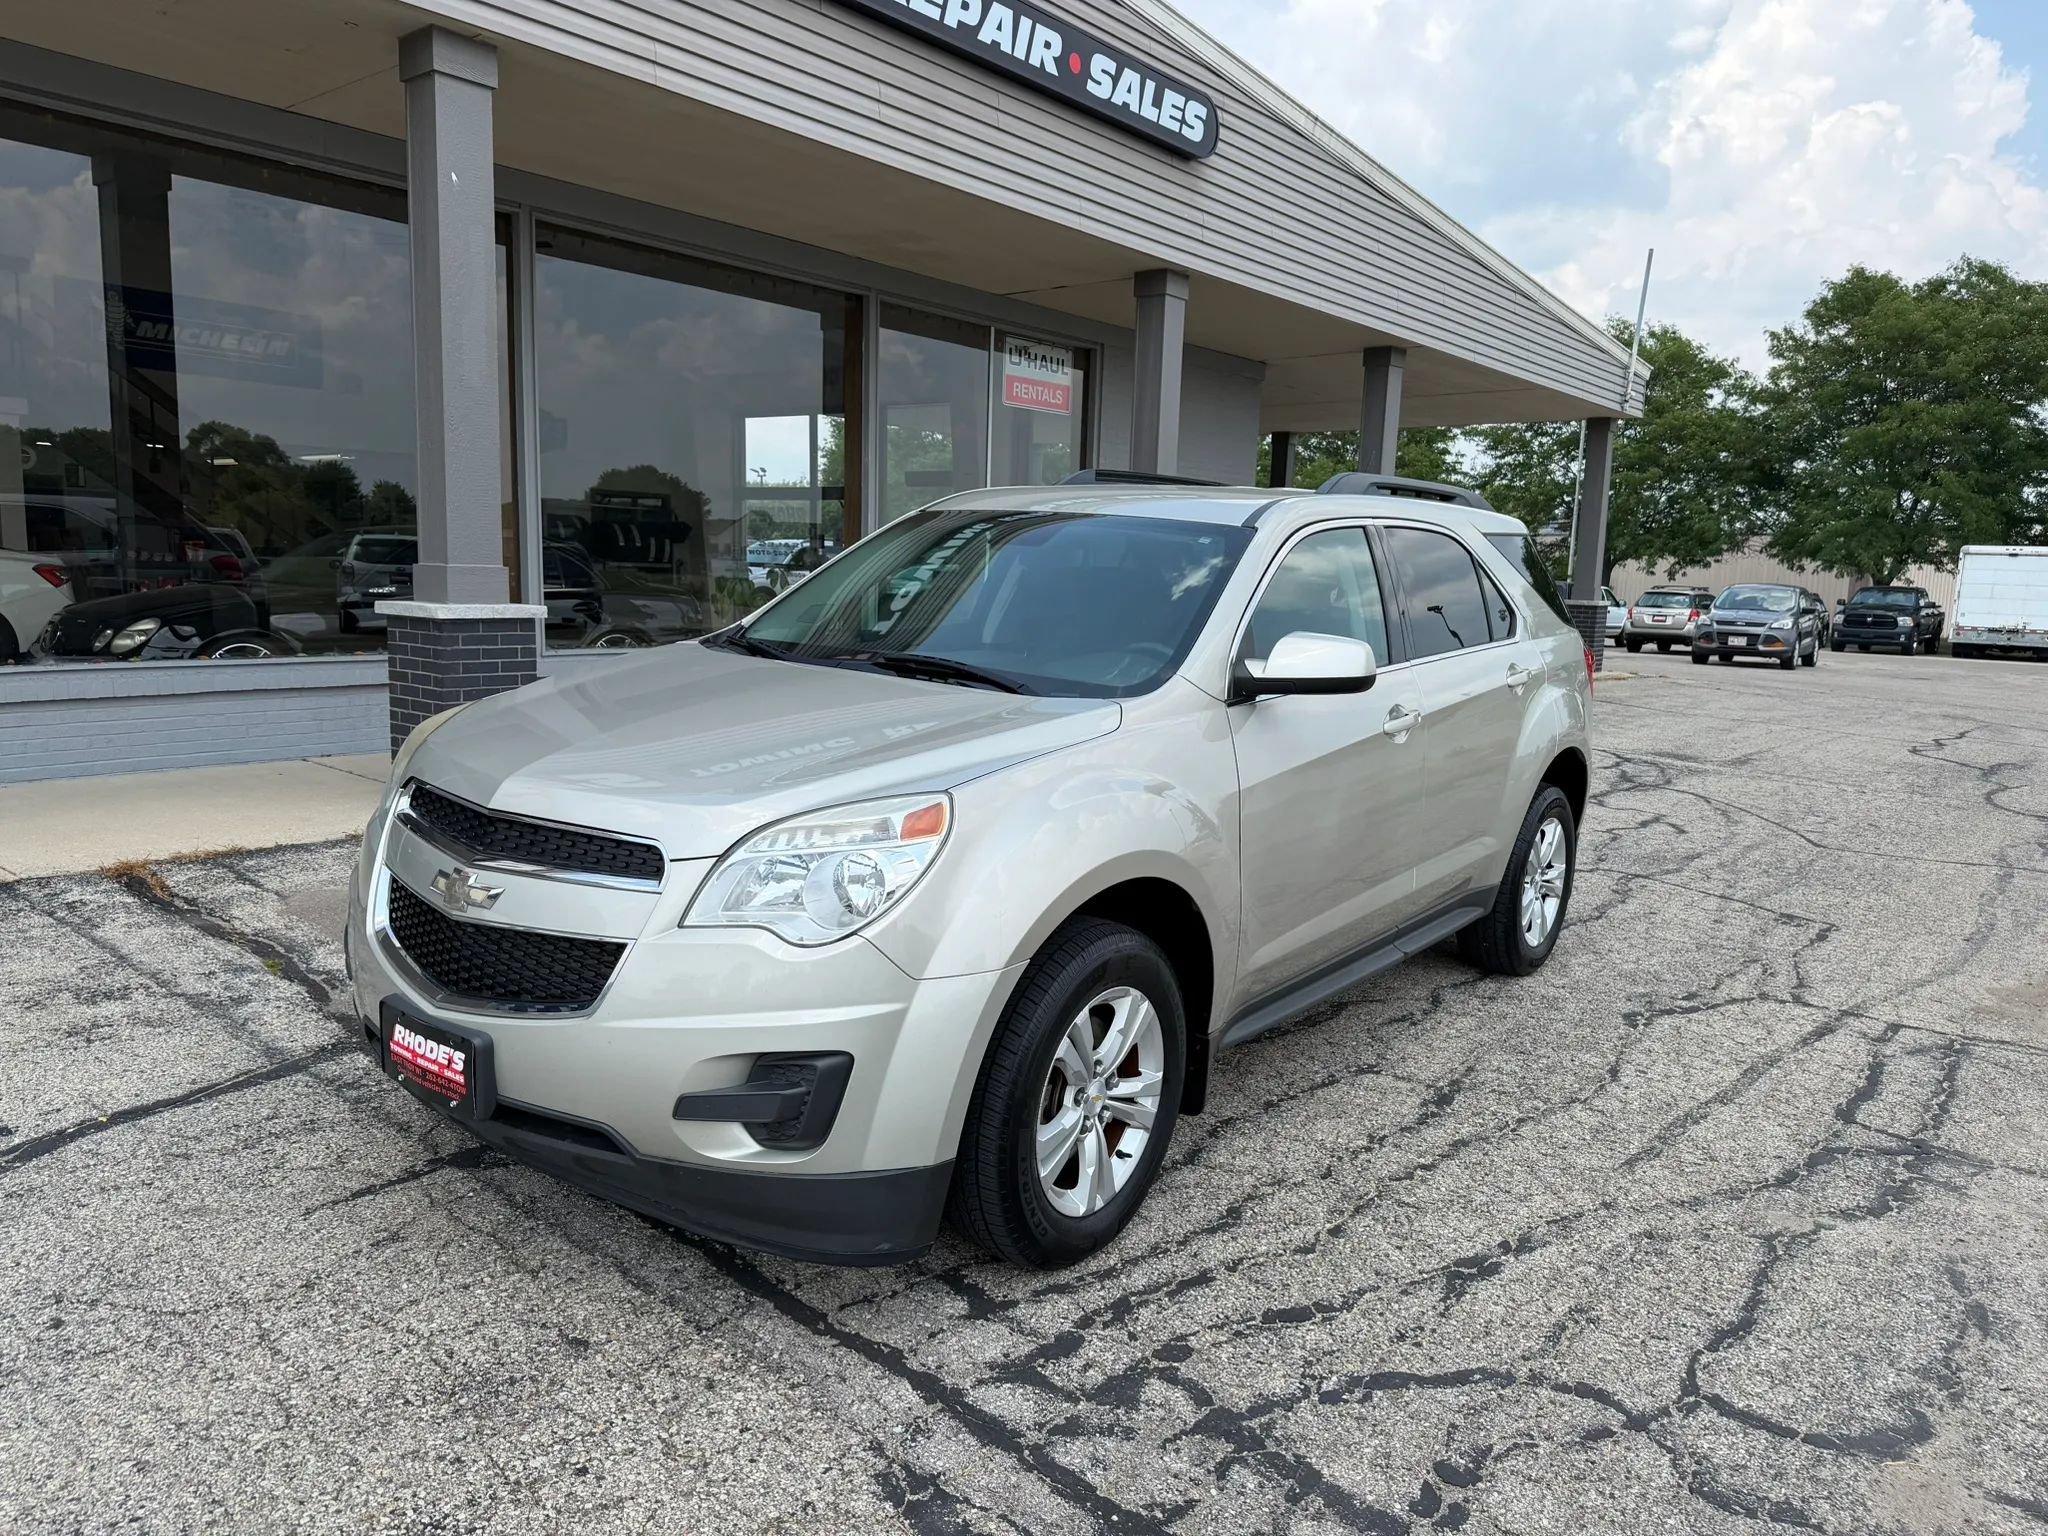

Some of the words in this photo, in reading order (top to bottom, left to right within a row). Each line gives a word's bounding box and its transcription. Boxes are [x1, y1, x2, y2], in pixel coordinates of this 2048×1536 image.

[894, 0, 1064, 77] PAIR
[1085, 52, 1208, 143] SALES
[136, 321, 290, 357] MICHELIN
[1013, 382, 1063, 404] RENTALS
[393, 1023, 466, 1072] RHODE'S
[416, 1057, 439, 1073] REPAIR
[443, 1068, 465, 1084] SALES
